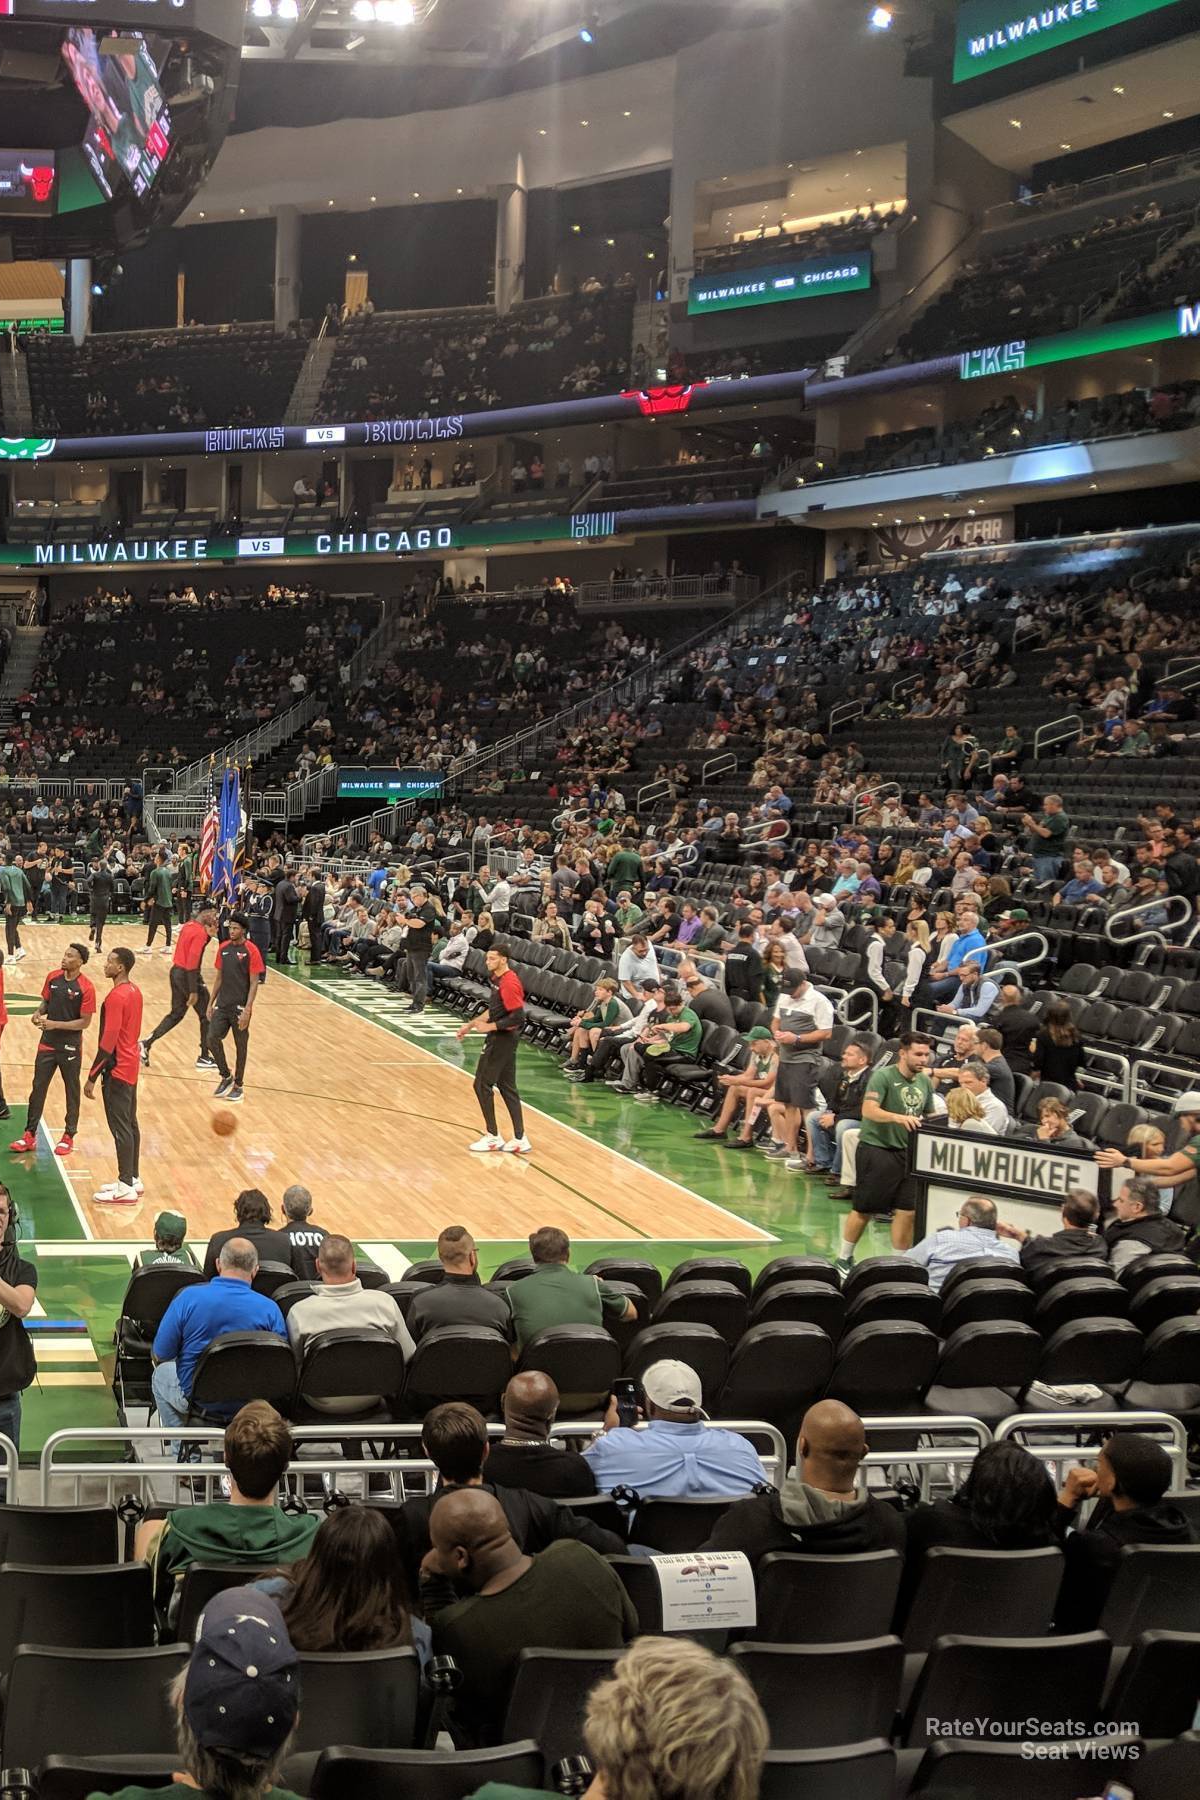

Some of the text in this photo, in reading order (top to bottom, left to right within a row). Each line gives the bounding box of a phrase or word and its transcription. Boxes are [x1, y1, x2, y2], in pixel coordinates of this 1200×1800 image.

[970, 0, 1099, 55] MILWAUKEE
[697, 281, 766, 301] MILWAUKEE
[803, 266, 860, 284] CHICAGO
[206, 415, 464, 452] BUCKS VS BULLS
[36, 527, 451, 563] MILWAUKEE VS CHICAGO
[930, 1140, 1081, 1194] MILWAUKEE
